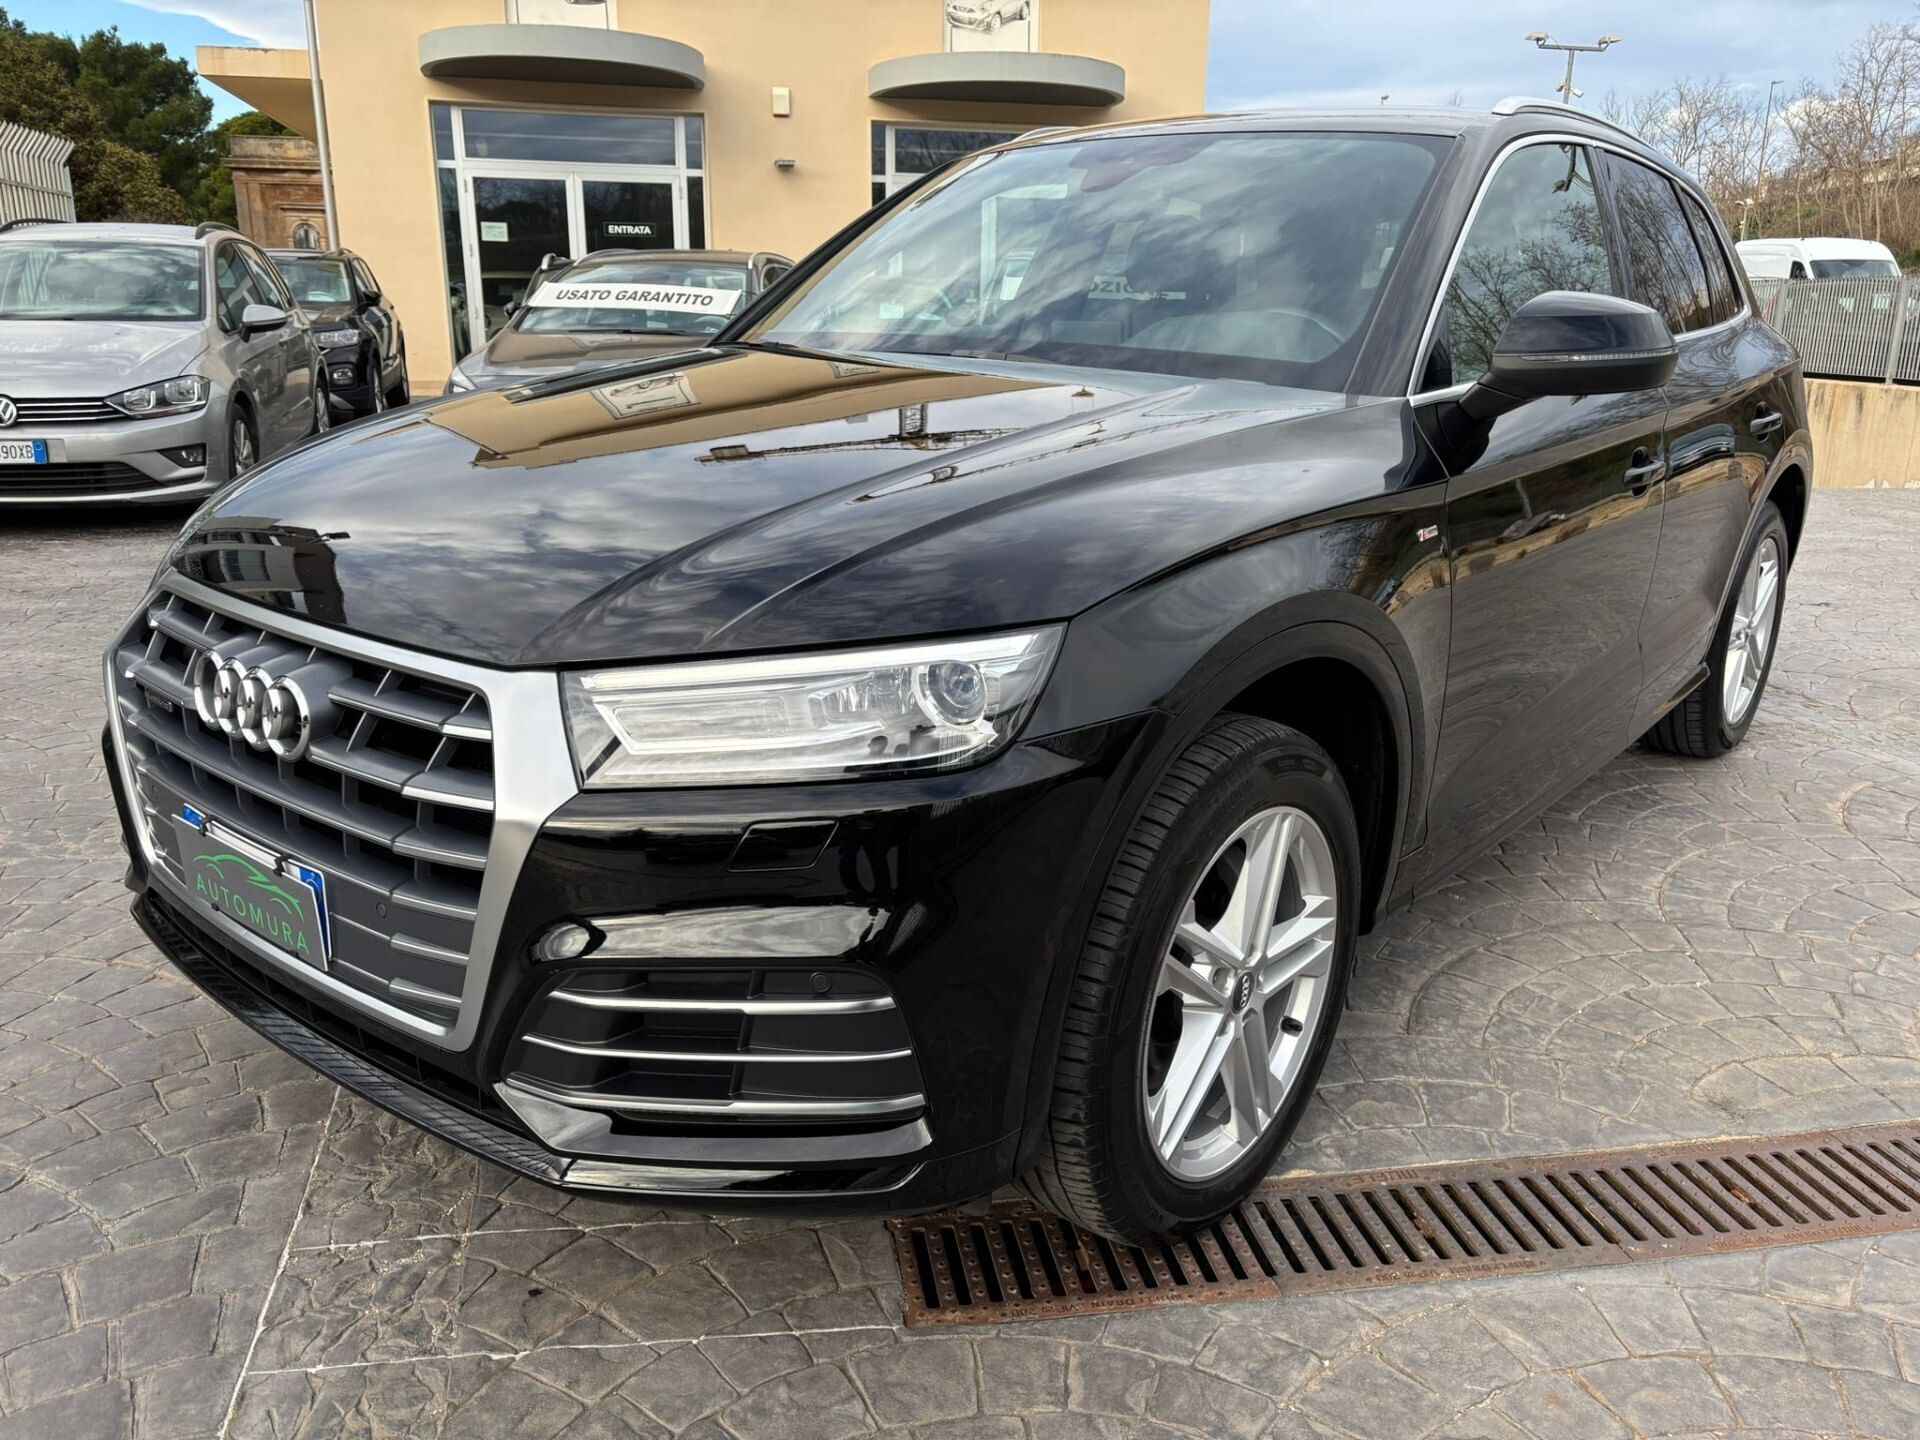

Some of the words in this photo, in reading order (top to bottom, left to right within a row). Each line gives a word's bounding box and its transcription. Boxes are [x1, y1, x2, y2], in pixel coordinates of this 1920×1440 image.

[608, 225, 651, 235] ENTRATA
[555, 289, 612, 301] USATO
[615, 290, 714, 306] GARANTITO
[0, 445, 33, 460] 90XB
[196, 873, 310, 955] AUTOMURA
